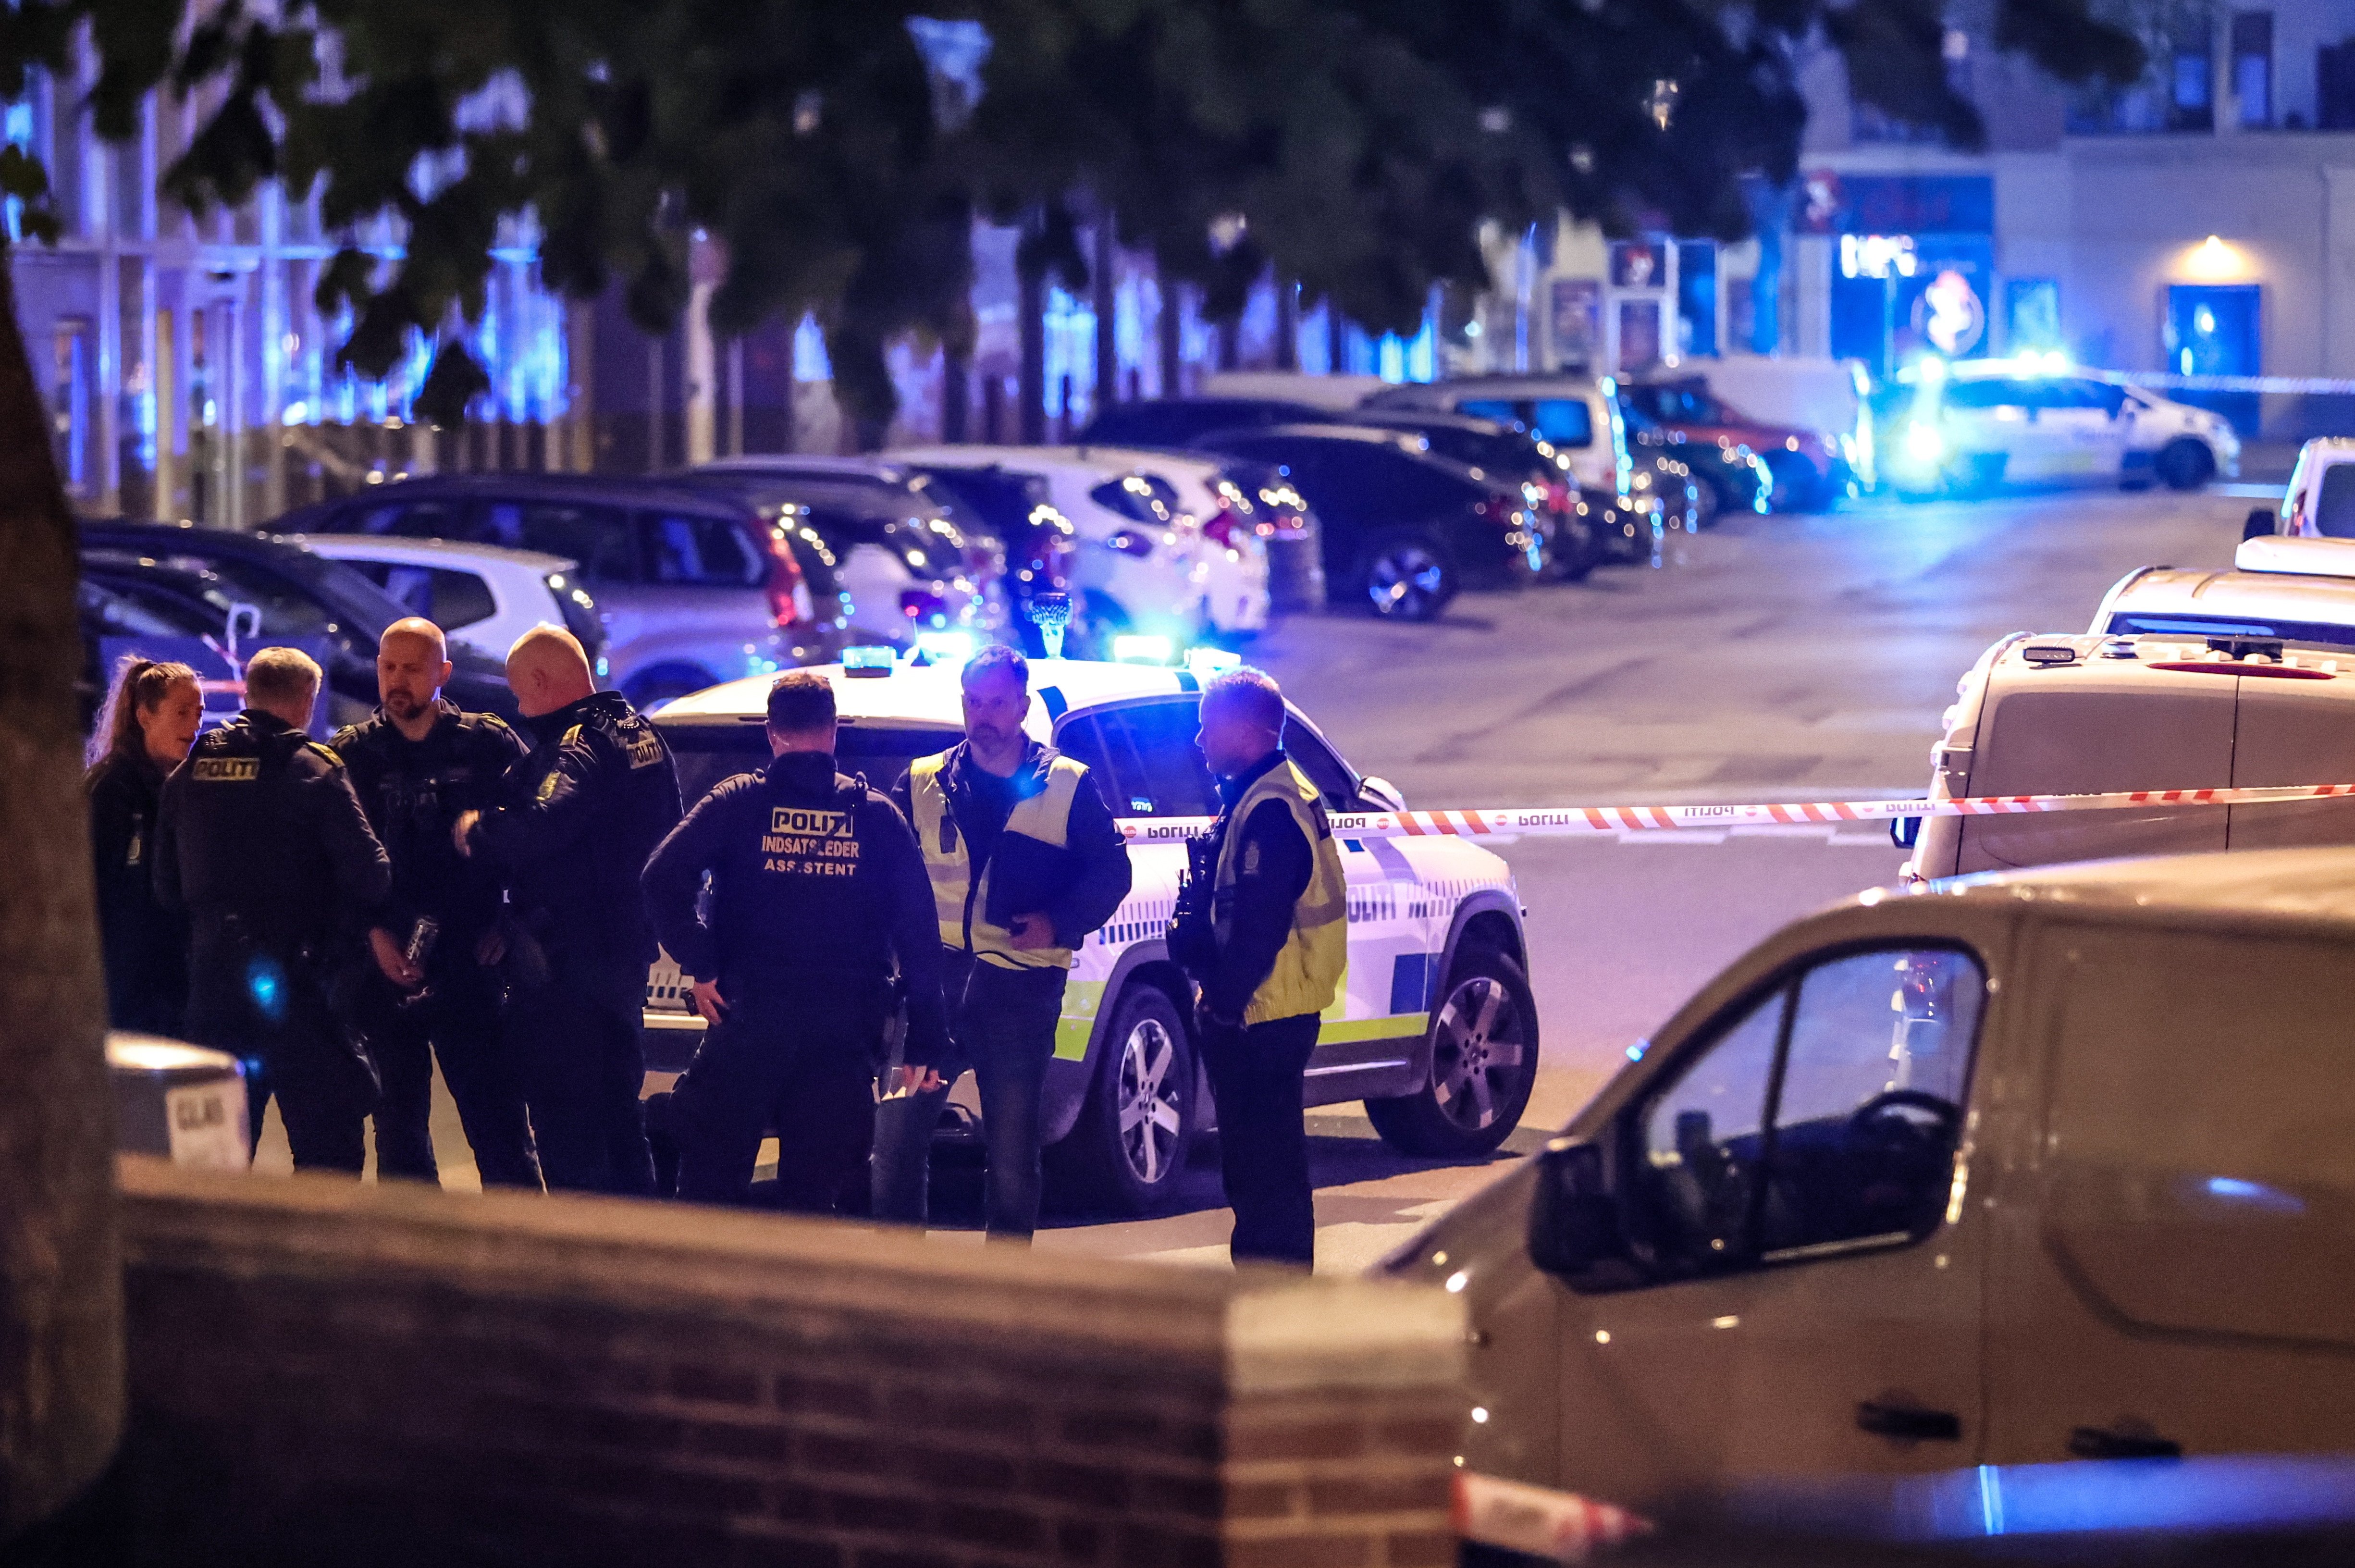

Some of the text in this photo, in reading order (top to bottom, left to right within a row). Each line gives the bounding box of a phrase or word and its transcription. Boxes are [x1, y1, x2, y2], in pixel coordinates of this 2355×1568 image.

[196, 761, 258, 777] POLITI
[764, 858, 856, 876] ASSSTENT
[1347, 886, 1396, 923] OLITI
